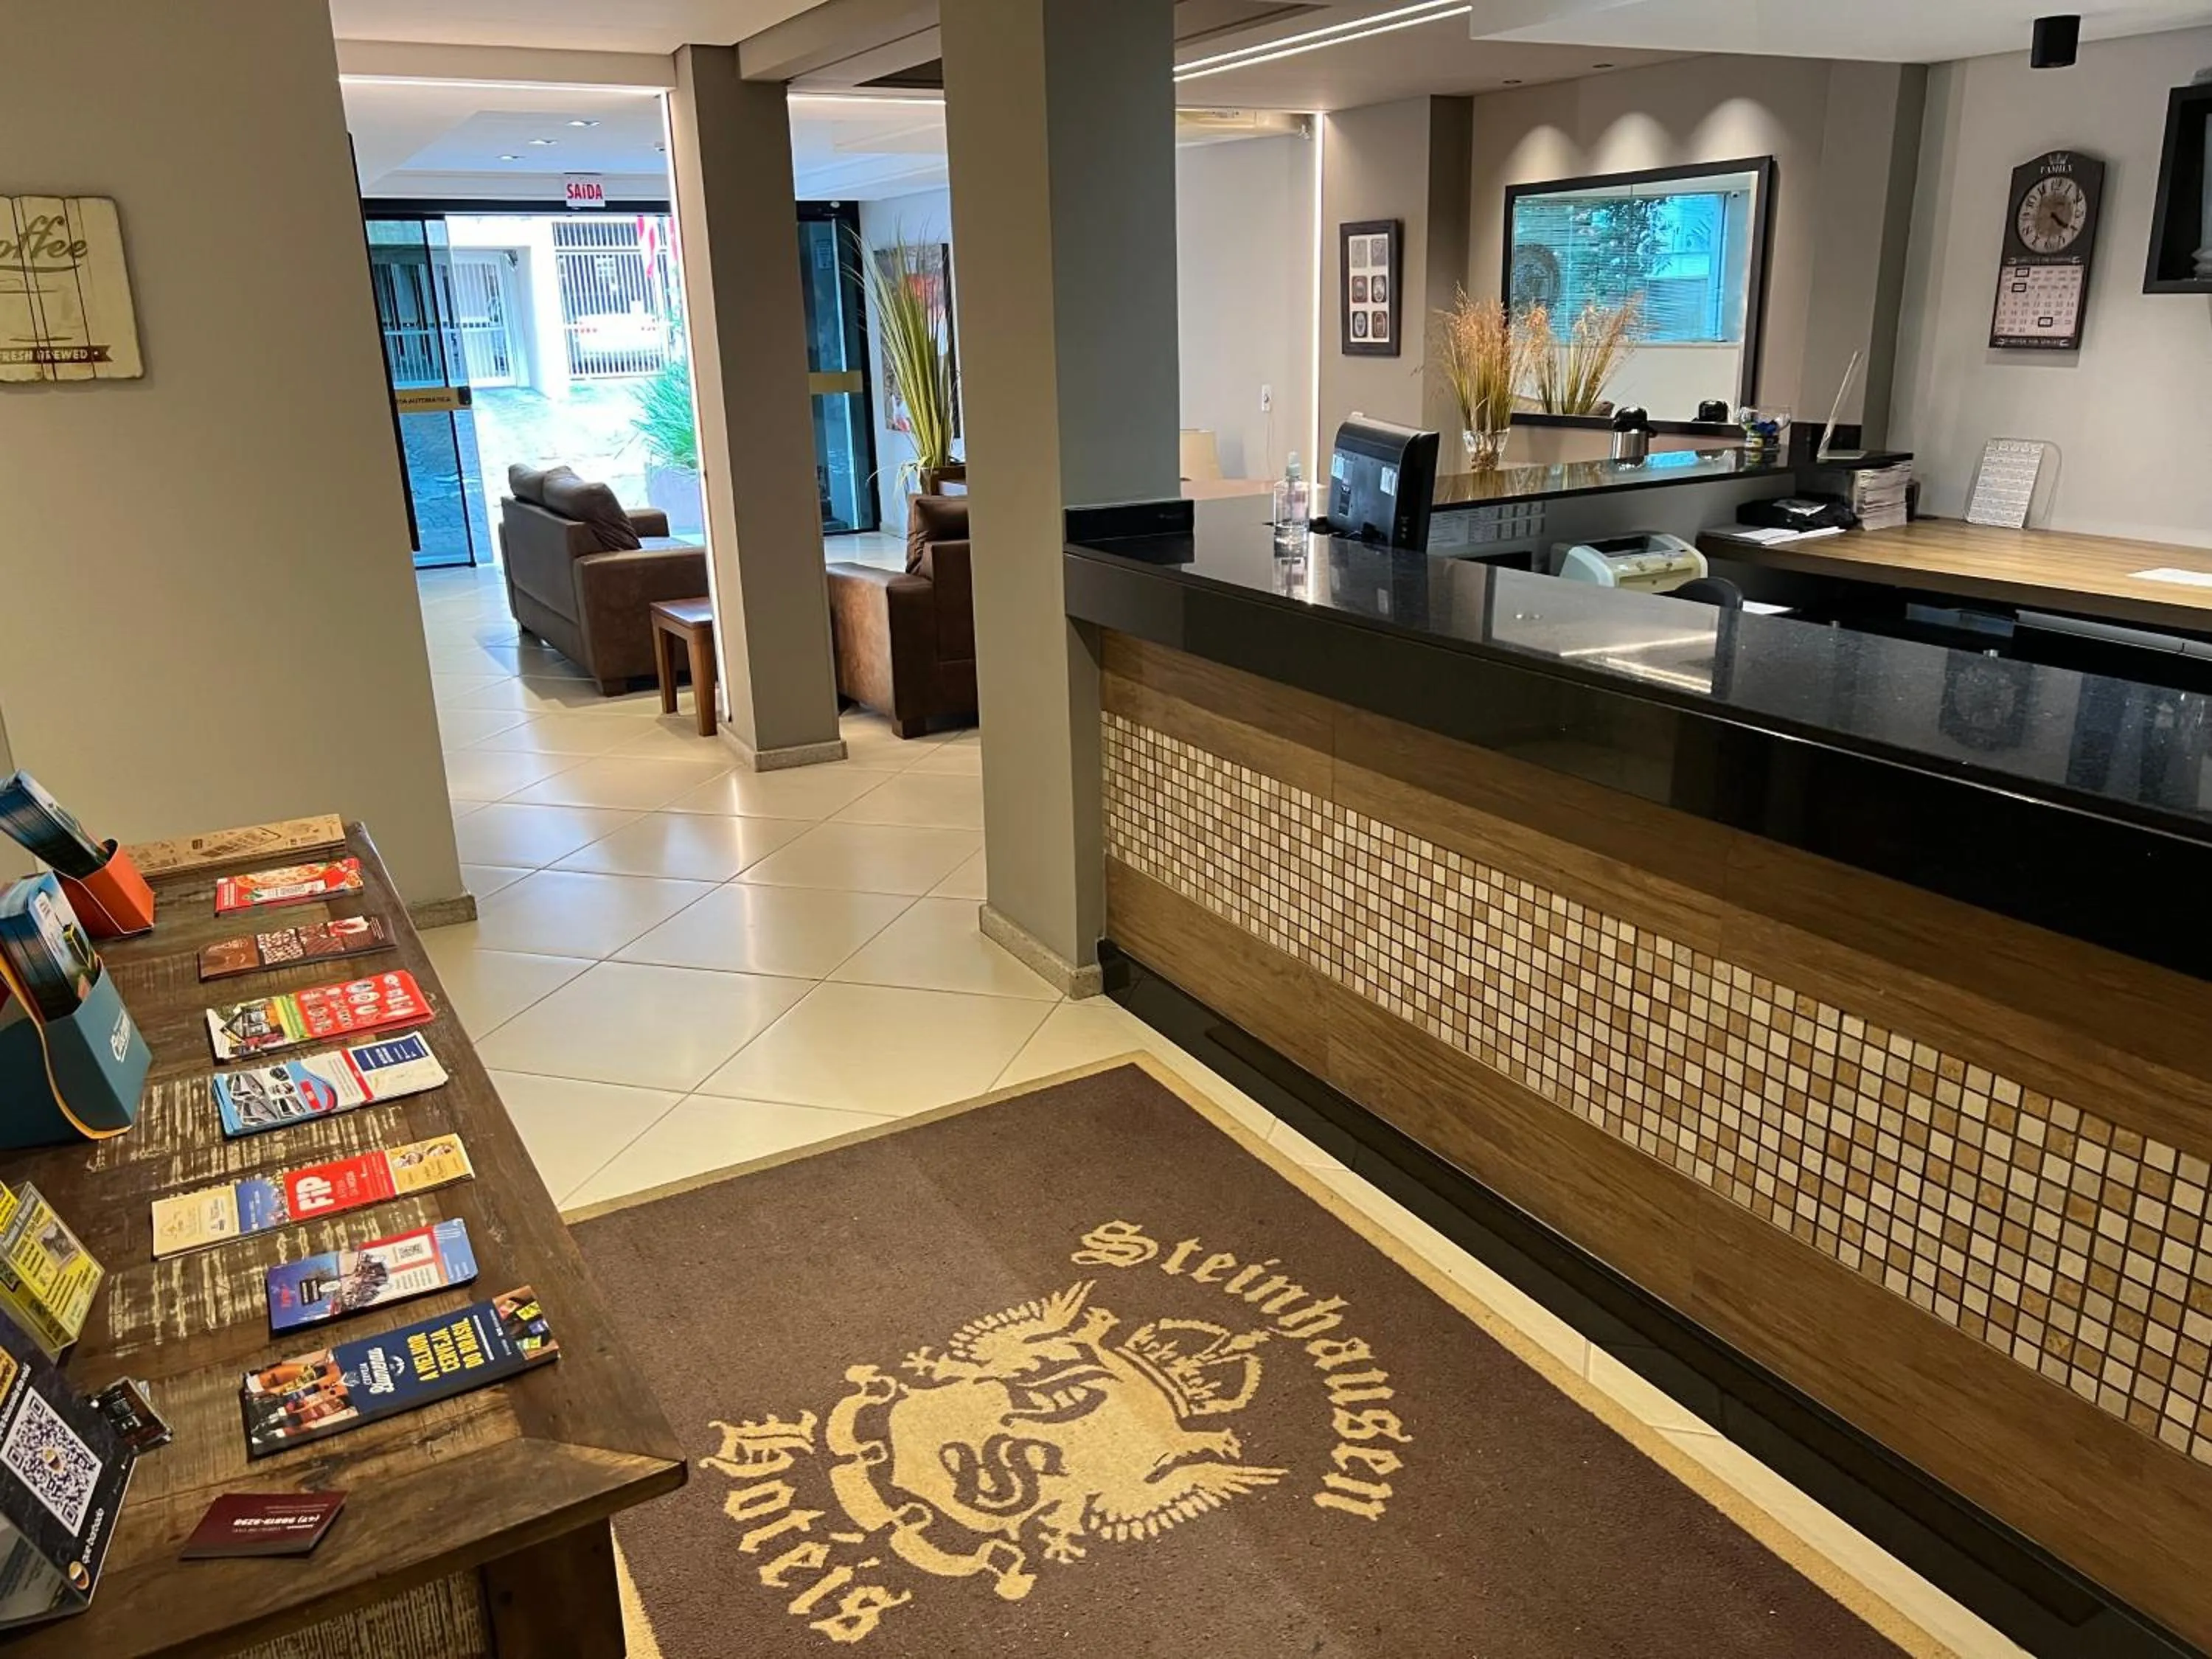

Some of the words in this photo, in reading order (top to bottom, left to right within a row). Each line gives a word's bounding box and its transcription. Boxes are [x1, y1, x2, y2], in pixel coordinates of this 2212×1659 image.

[0, 215, 88, 260] offee
[406, 1332, 437, 1374] MELHOR
[429, 1326, 461, 1373] CERVEJA
[451, 1317, 480, 1354] BRASIL
[419, 1370, 440, 1381] A
[462, 1351, 485, 1369] DO
[1070, 1219, 1413, 1522] Steinhausen
